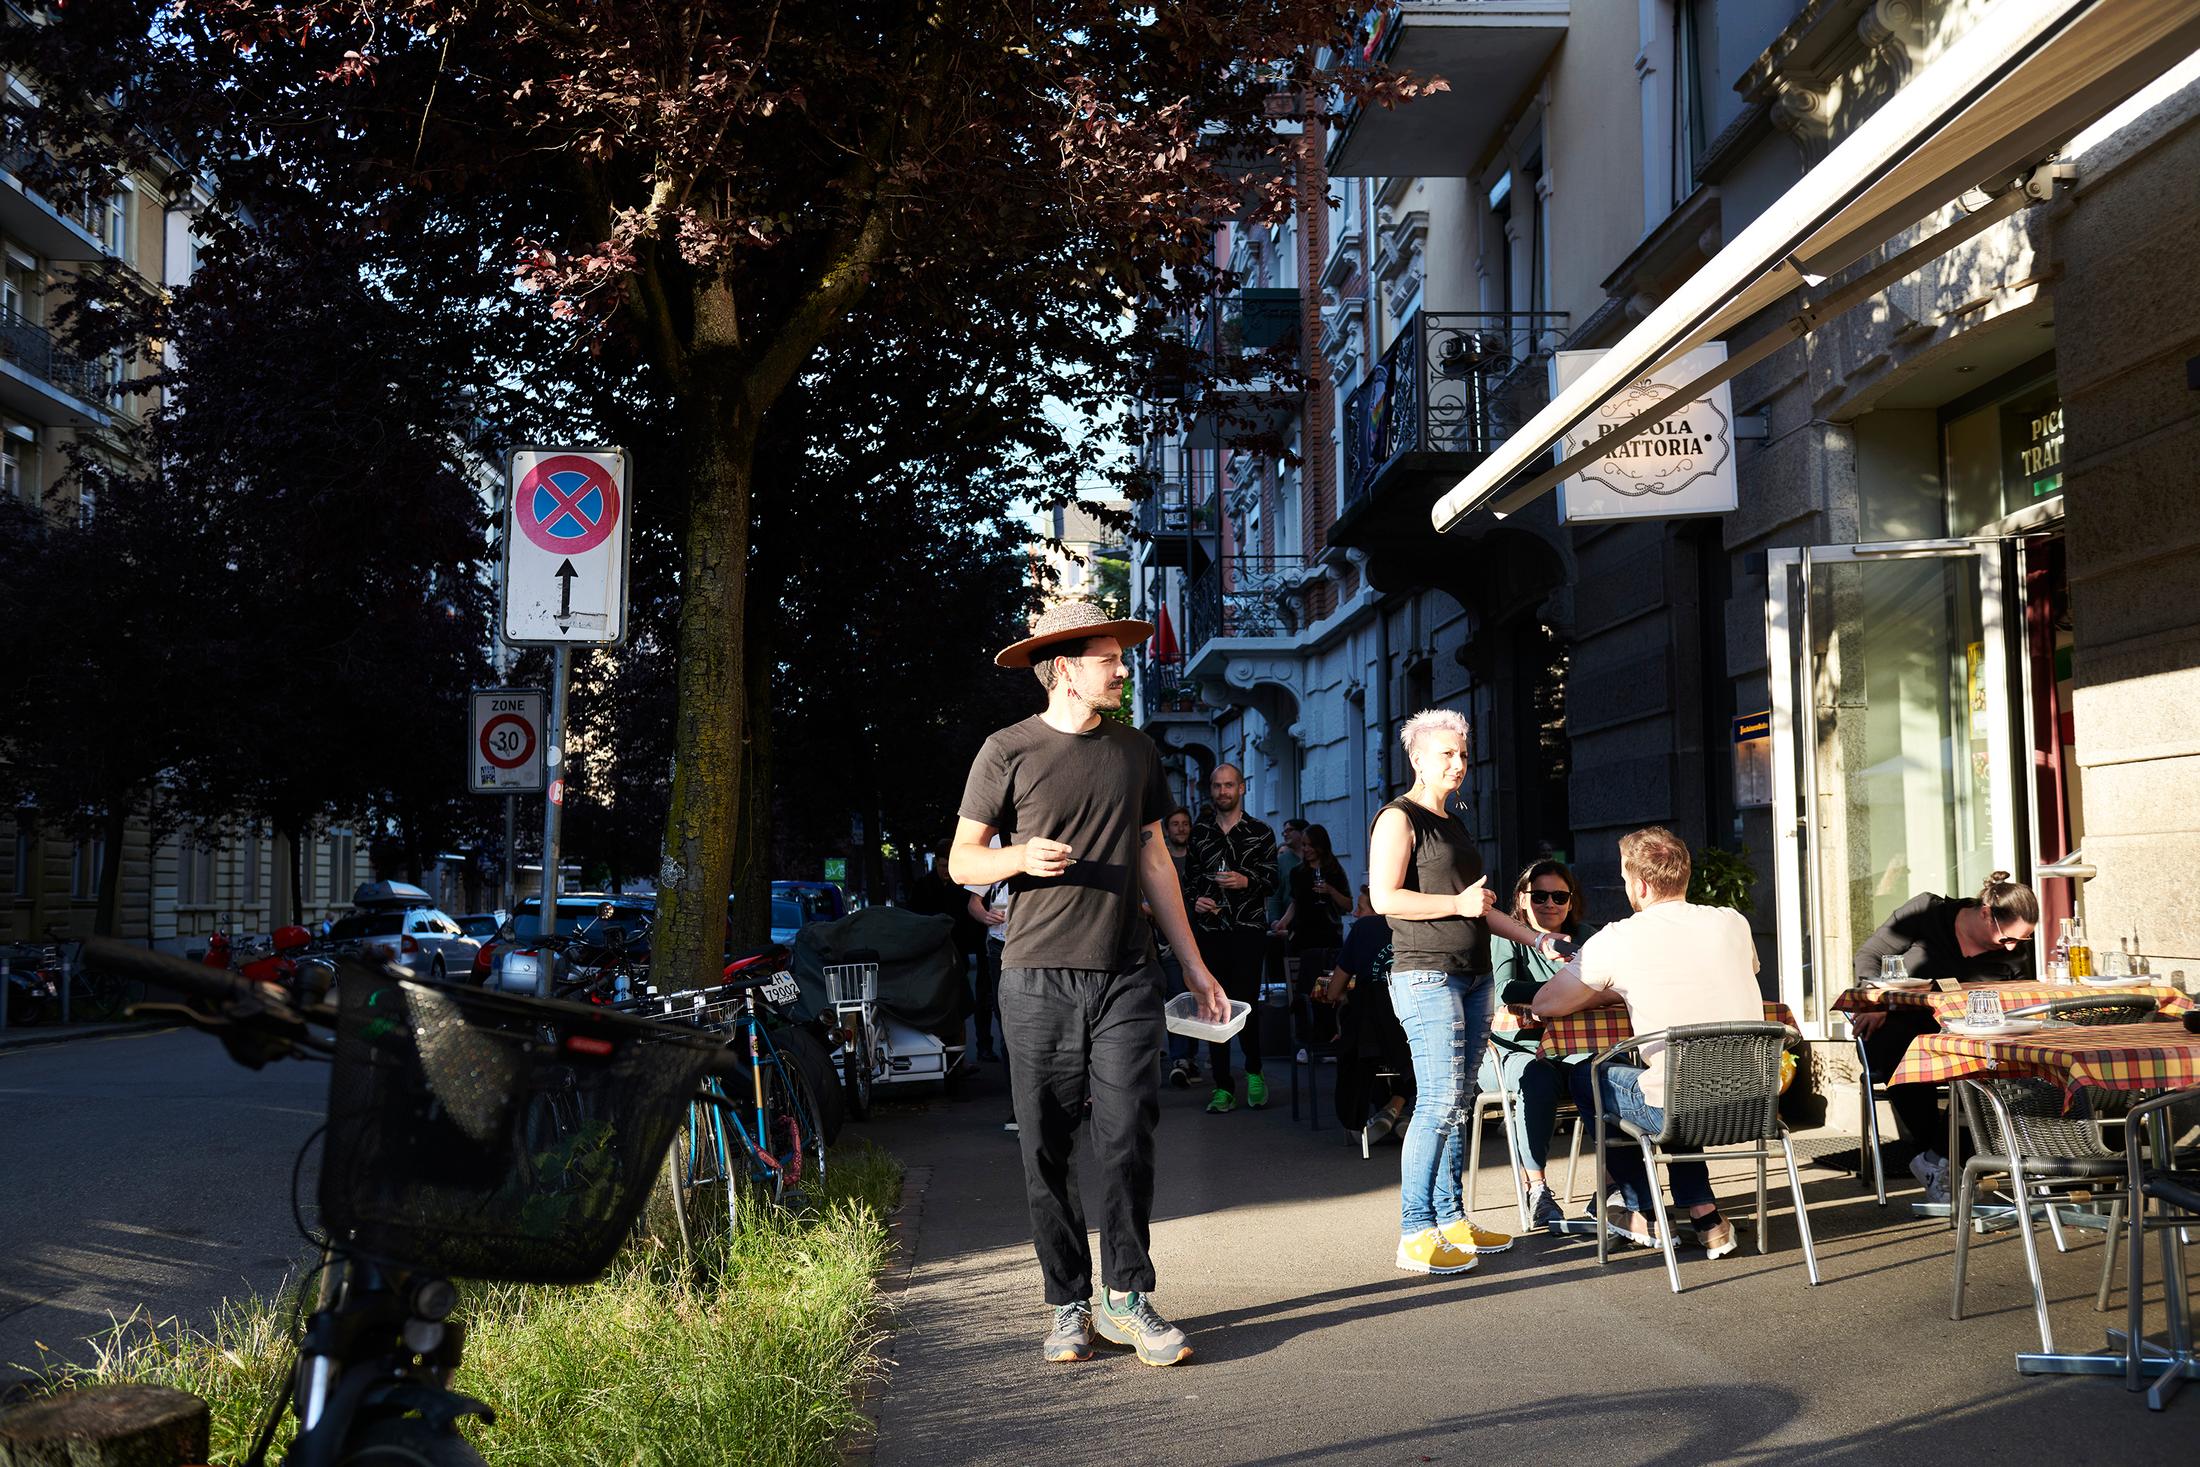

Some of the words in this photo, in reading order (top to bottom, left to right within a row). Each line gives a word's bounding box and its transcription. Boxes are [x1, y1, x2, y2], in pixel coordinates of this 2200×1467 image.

[492, 700, 525, 711] ZONE
[497, 731, 519, 751] 30
[765, 983, 799, 1001] 79002
